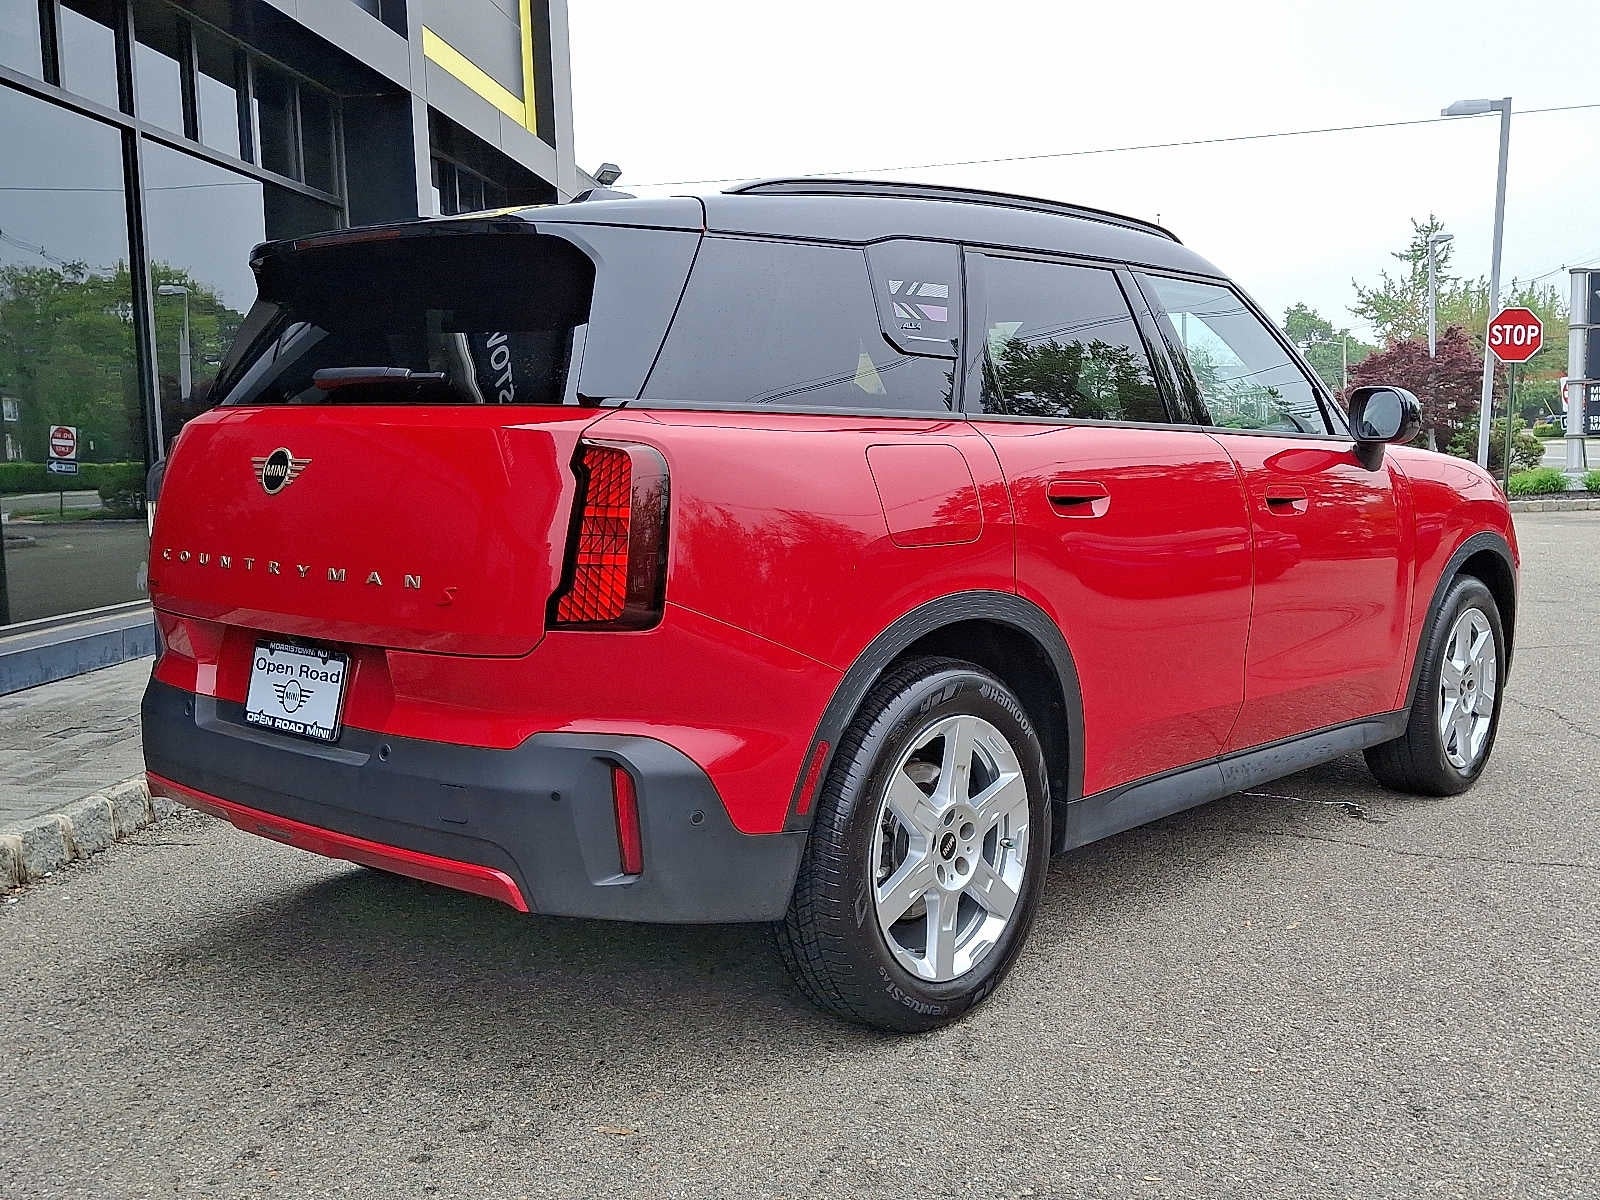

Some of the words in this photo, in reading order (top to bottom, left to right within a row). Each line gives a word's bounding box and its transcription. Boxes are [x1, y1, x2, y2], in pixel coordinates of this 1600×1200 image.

[1490, 324, 1540, 346] STOP
[265, 464, 287, 477] MINI
[162, 548, 422, 590] COUNTRYMAN
[317, 650, 329, 658] NJ
[256, 657, 294, 676] Open
[299, 664, 341, 684] Road
[246, 712, 273, 726] OPEN
[275, 719, 304, 733] ROAD
[306, 725, 330, 739] MINI
